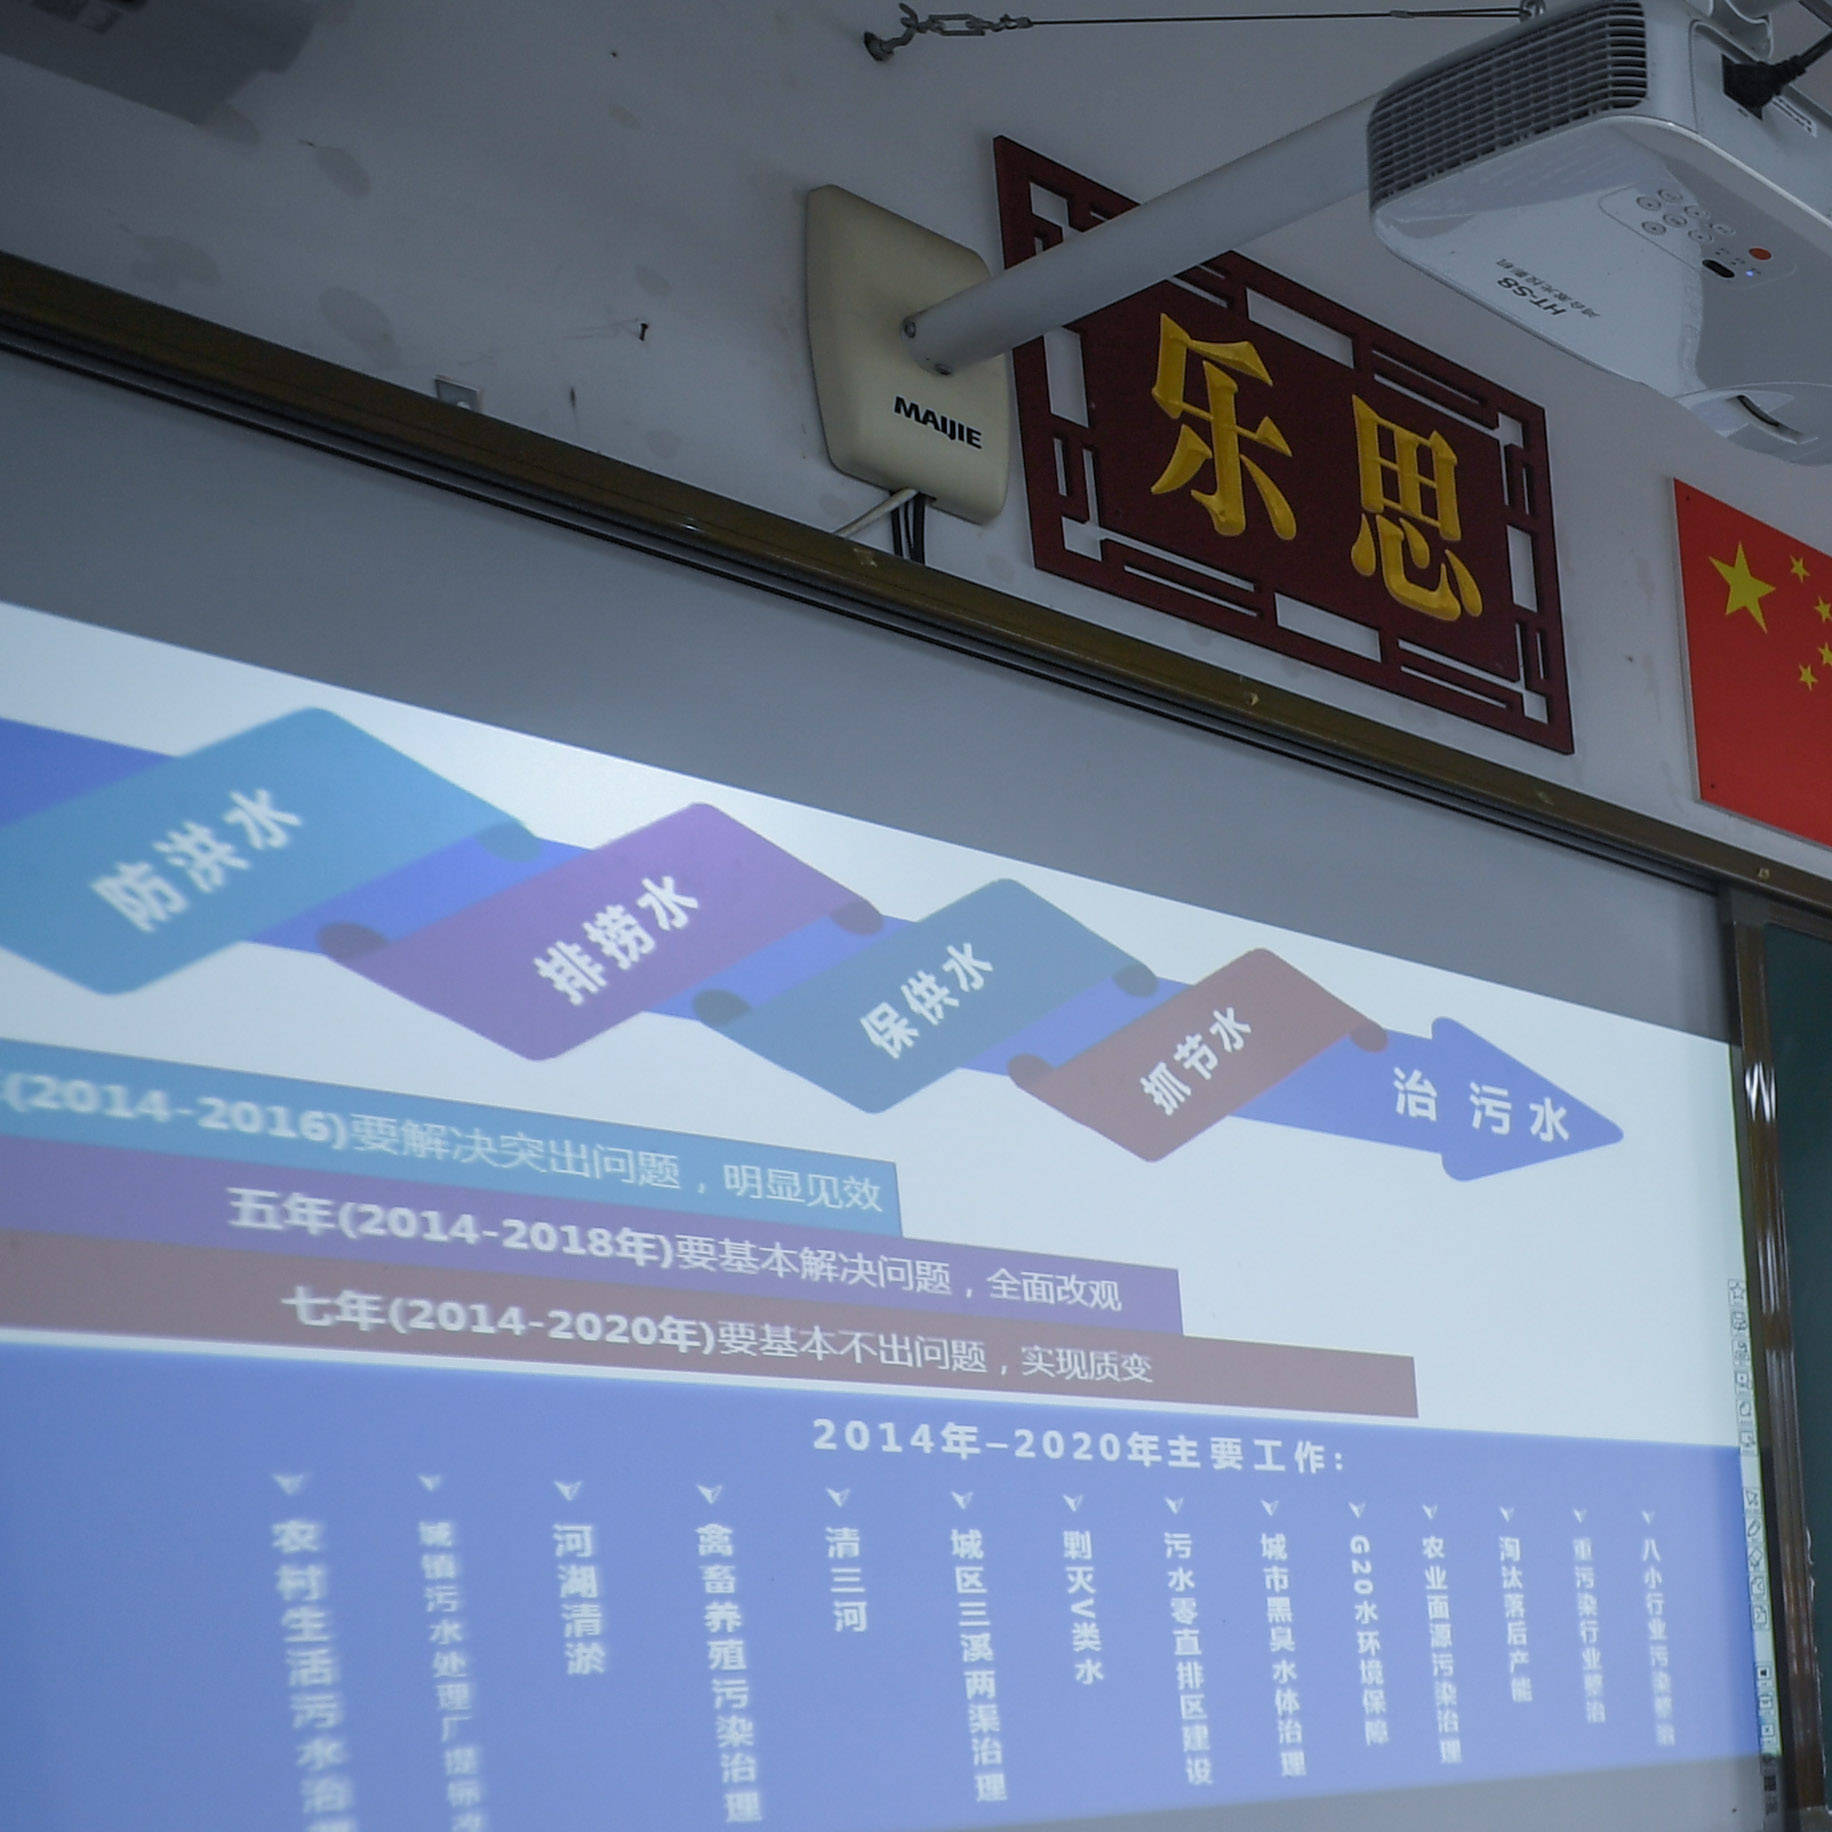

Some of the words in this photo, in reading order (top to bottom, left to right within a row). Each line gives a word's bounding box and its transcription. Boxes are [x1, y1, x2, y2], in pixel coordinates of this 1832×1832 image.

[1496, 278, 1567, 316] HT-S8
[893, 395, 984, 450] MAIJIE
[1150, 311, 1484, 623] 乐思
[91, 788, 304, 934] 防洪水
[859, 940, 995, 1061] 保供水
[1139, 1005, 1253, 1117] 抓节水
[1392, 1066, 1572, 1143] 治污水
[552, 1523, 606, 1675] 河湖清淤
[826, 1526, 868, 1633] 清三河
[1349, 1534, 1389, 1746] G20水环境保障
[1164, 1532, 1213, 1785] 污水零直排区建设
[1260, 1533, 1306, 1777] 城市黑臭水体治理
